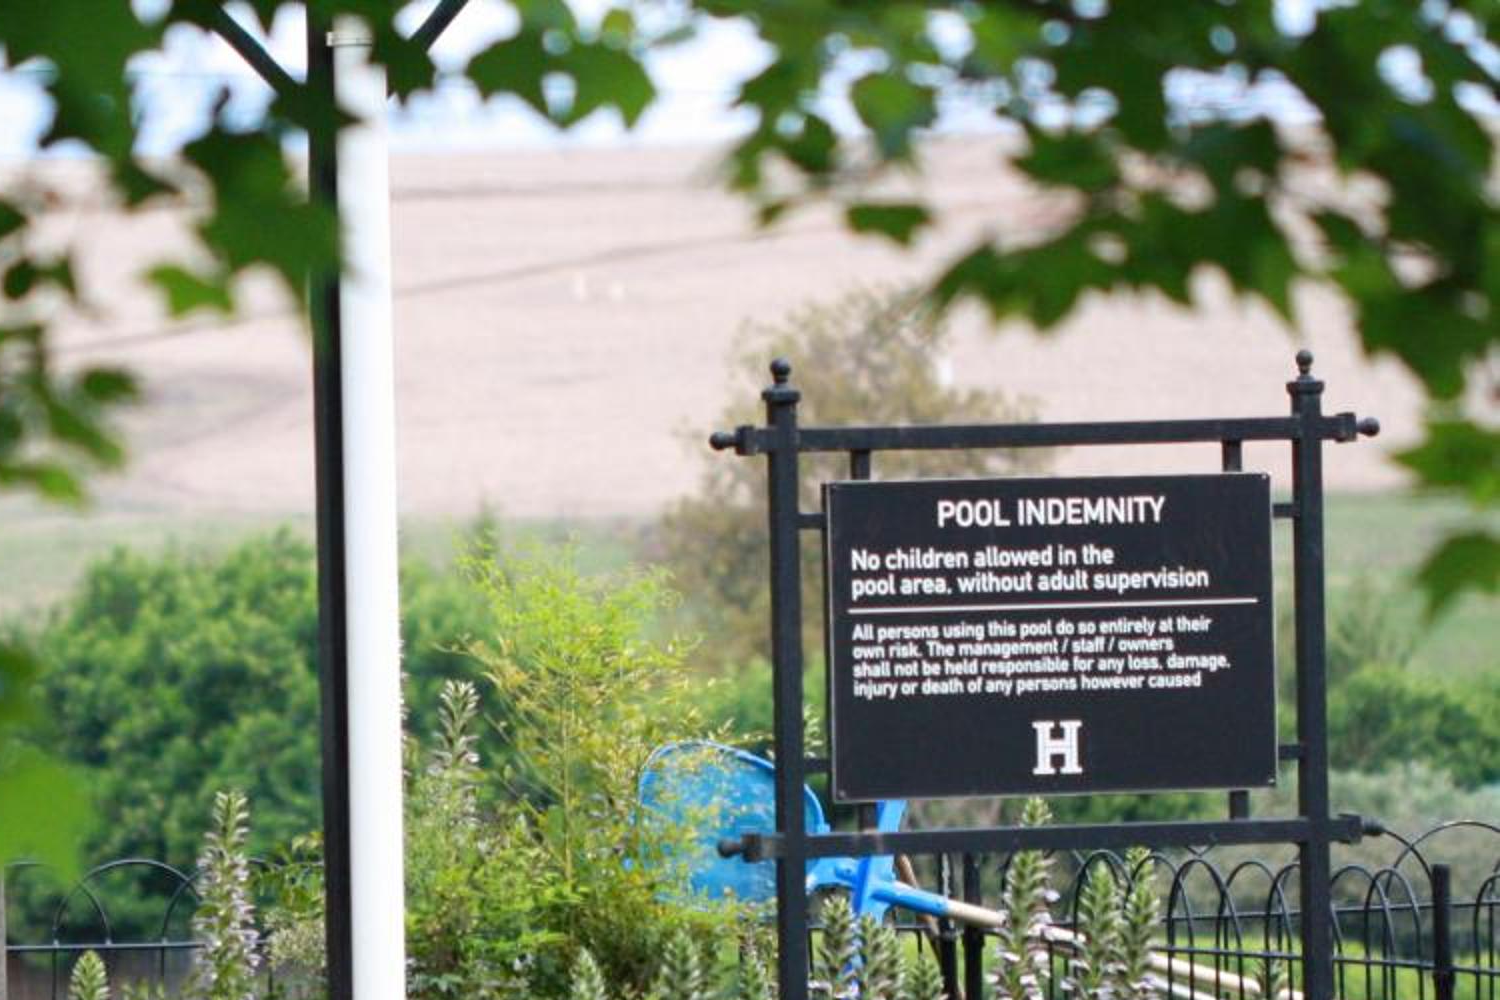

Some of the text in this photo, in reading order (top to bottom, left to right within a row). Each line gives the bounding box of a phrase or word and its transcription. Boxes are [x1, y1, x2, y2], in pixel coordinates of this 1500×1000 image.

[937, 496, 1166, 528] POOL INDEMNITY
[851, 544, 1115, 571] No children allowed in the
[851, 573, 897, 602] pool
[957, 571, 1033, 593] without
[1037, 569, 1089, 592] adult
[1093, 566, 1209, 595] supervision
[852, 615, 1212, 643] All persons using this pool do so entirely at their
[852, 644, 885, 660] own
[927, 640, 955, 657] The
[958, 639, 1059, 659] management
[1072, 636, 1106, 653] staff
[1118, 637, 1175, 652] owners
[853, 660, 891, 678] shall
[894, 661, 919, 678] not
[922, 659, 941, 676] be
[944, 658, 978, 675] held
[981, 655, 1069, 677] responsible
[1073, 655, 1095, 672] for
[1097, 657, 1125, 674] any
[853, 671, 1202, 700] injury or death of any persons however caused
[1032, 719, 1083, 775] H
